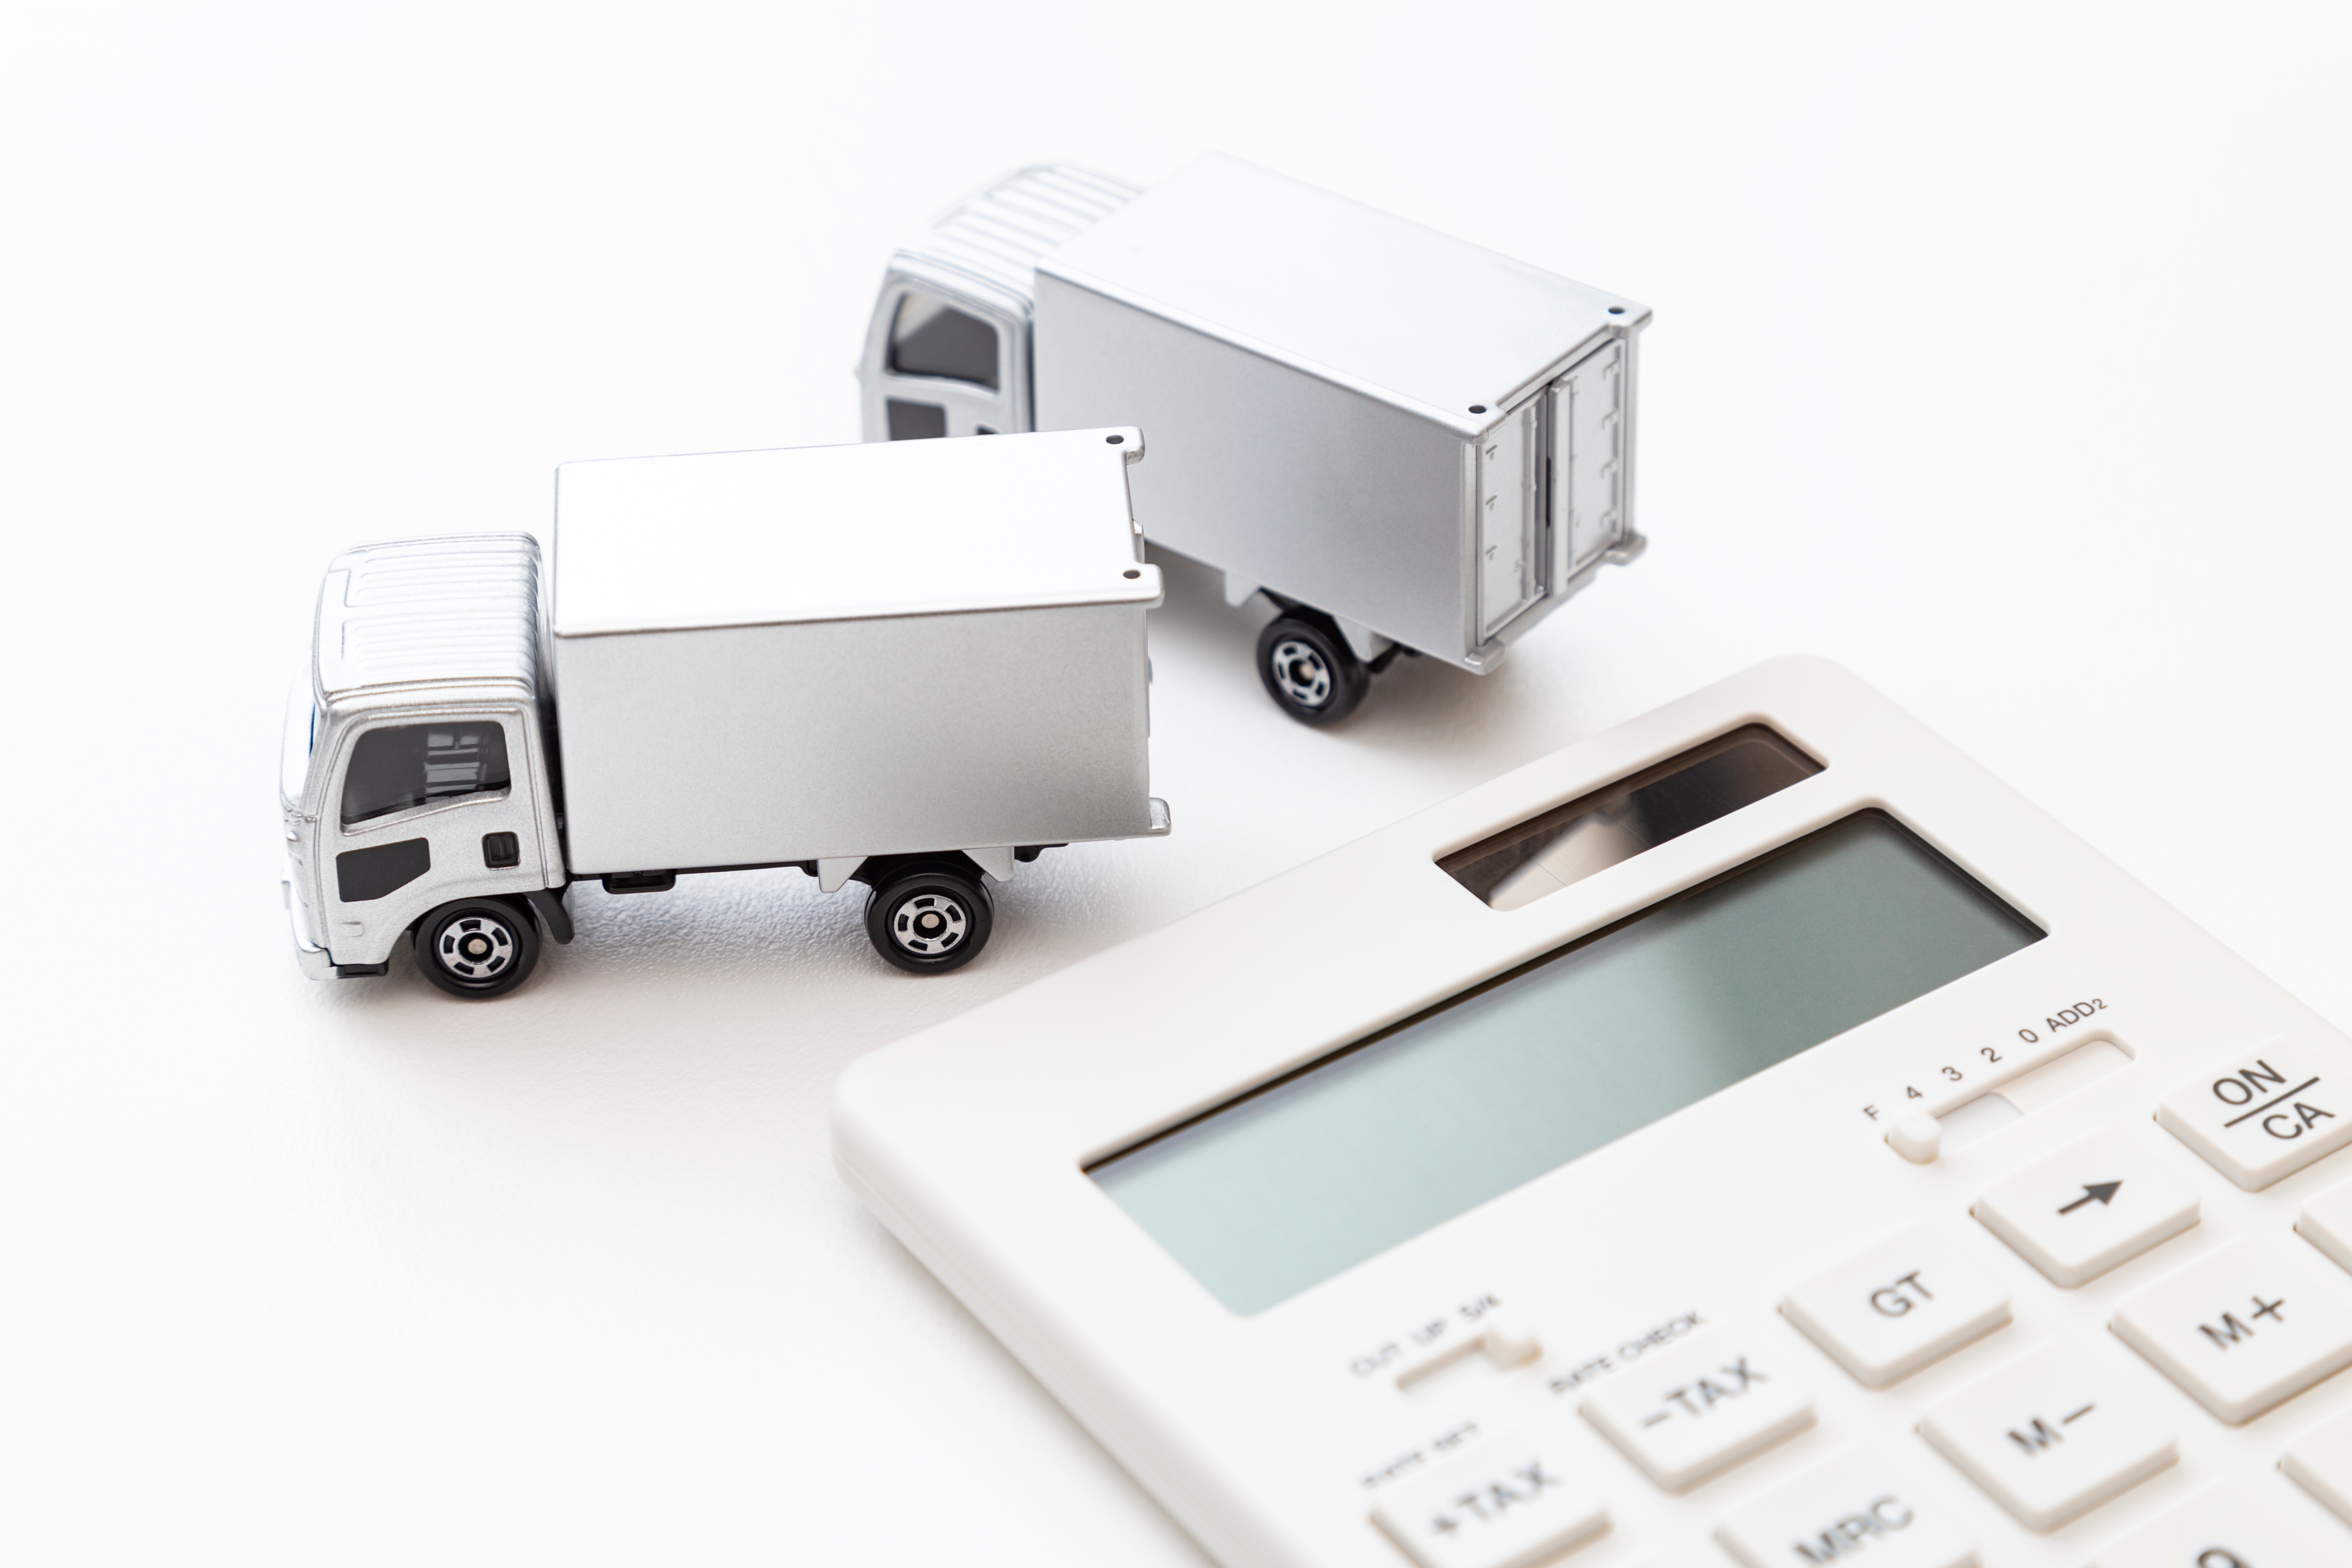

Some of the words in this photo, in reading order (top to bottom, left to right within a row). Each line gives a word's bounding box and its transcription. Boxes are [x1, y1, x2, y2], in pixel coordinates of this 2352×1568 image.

[1862, 1105, 1879, 1121] F
[1906, 1085, 1923, 1100] 4
[1941, 1066, 1963, 1082] 3
[1980, 1047, 2002, 1063] 2
[2212, 1059, 2286, 1106] ON
[2262, 1102, 2336, 1141] CA
[1869, 1270, 1934, 1318] GT
[2198, 1296, 2285, 1350] M+
[1793, 1496, 1915, 1565] MRC
